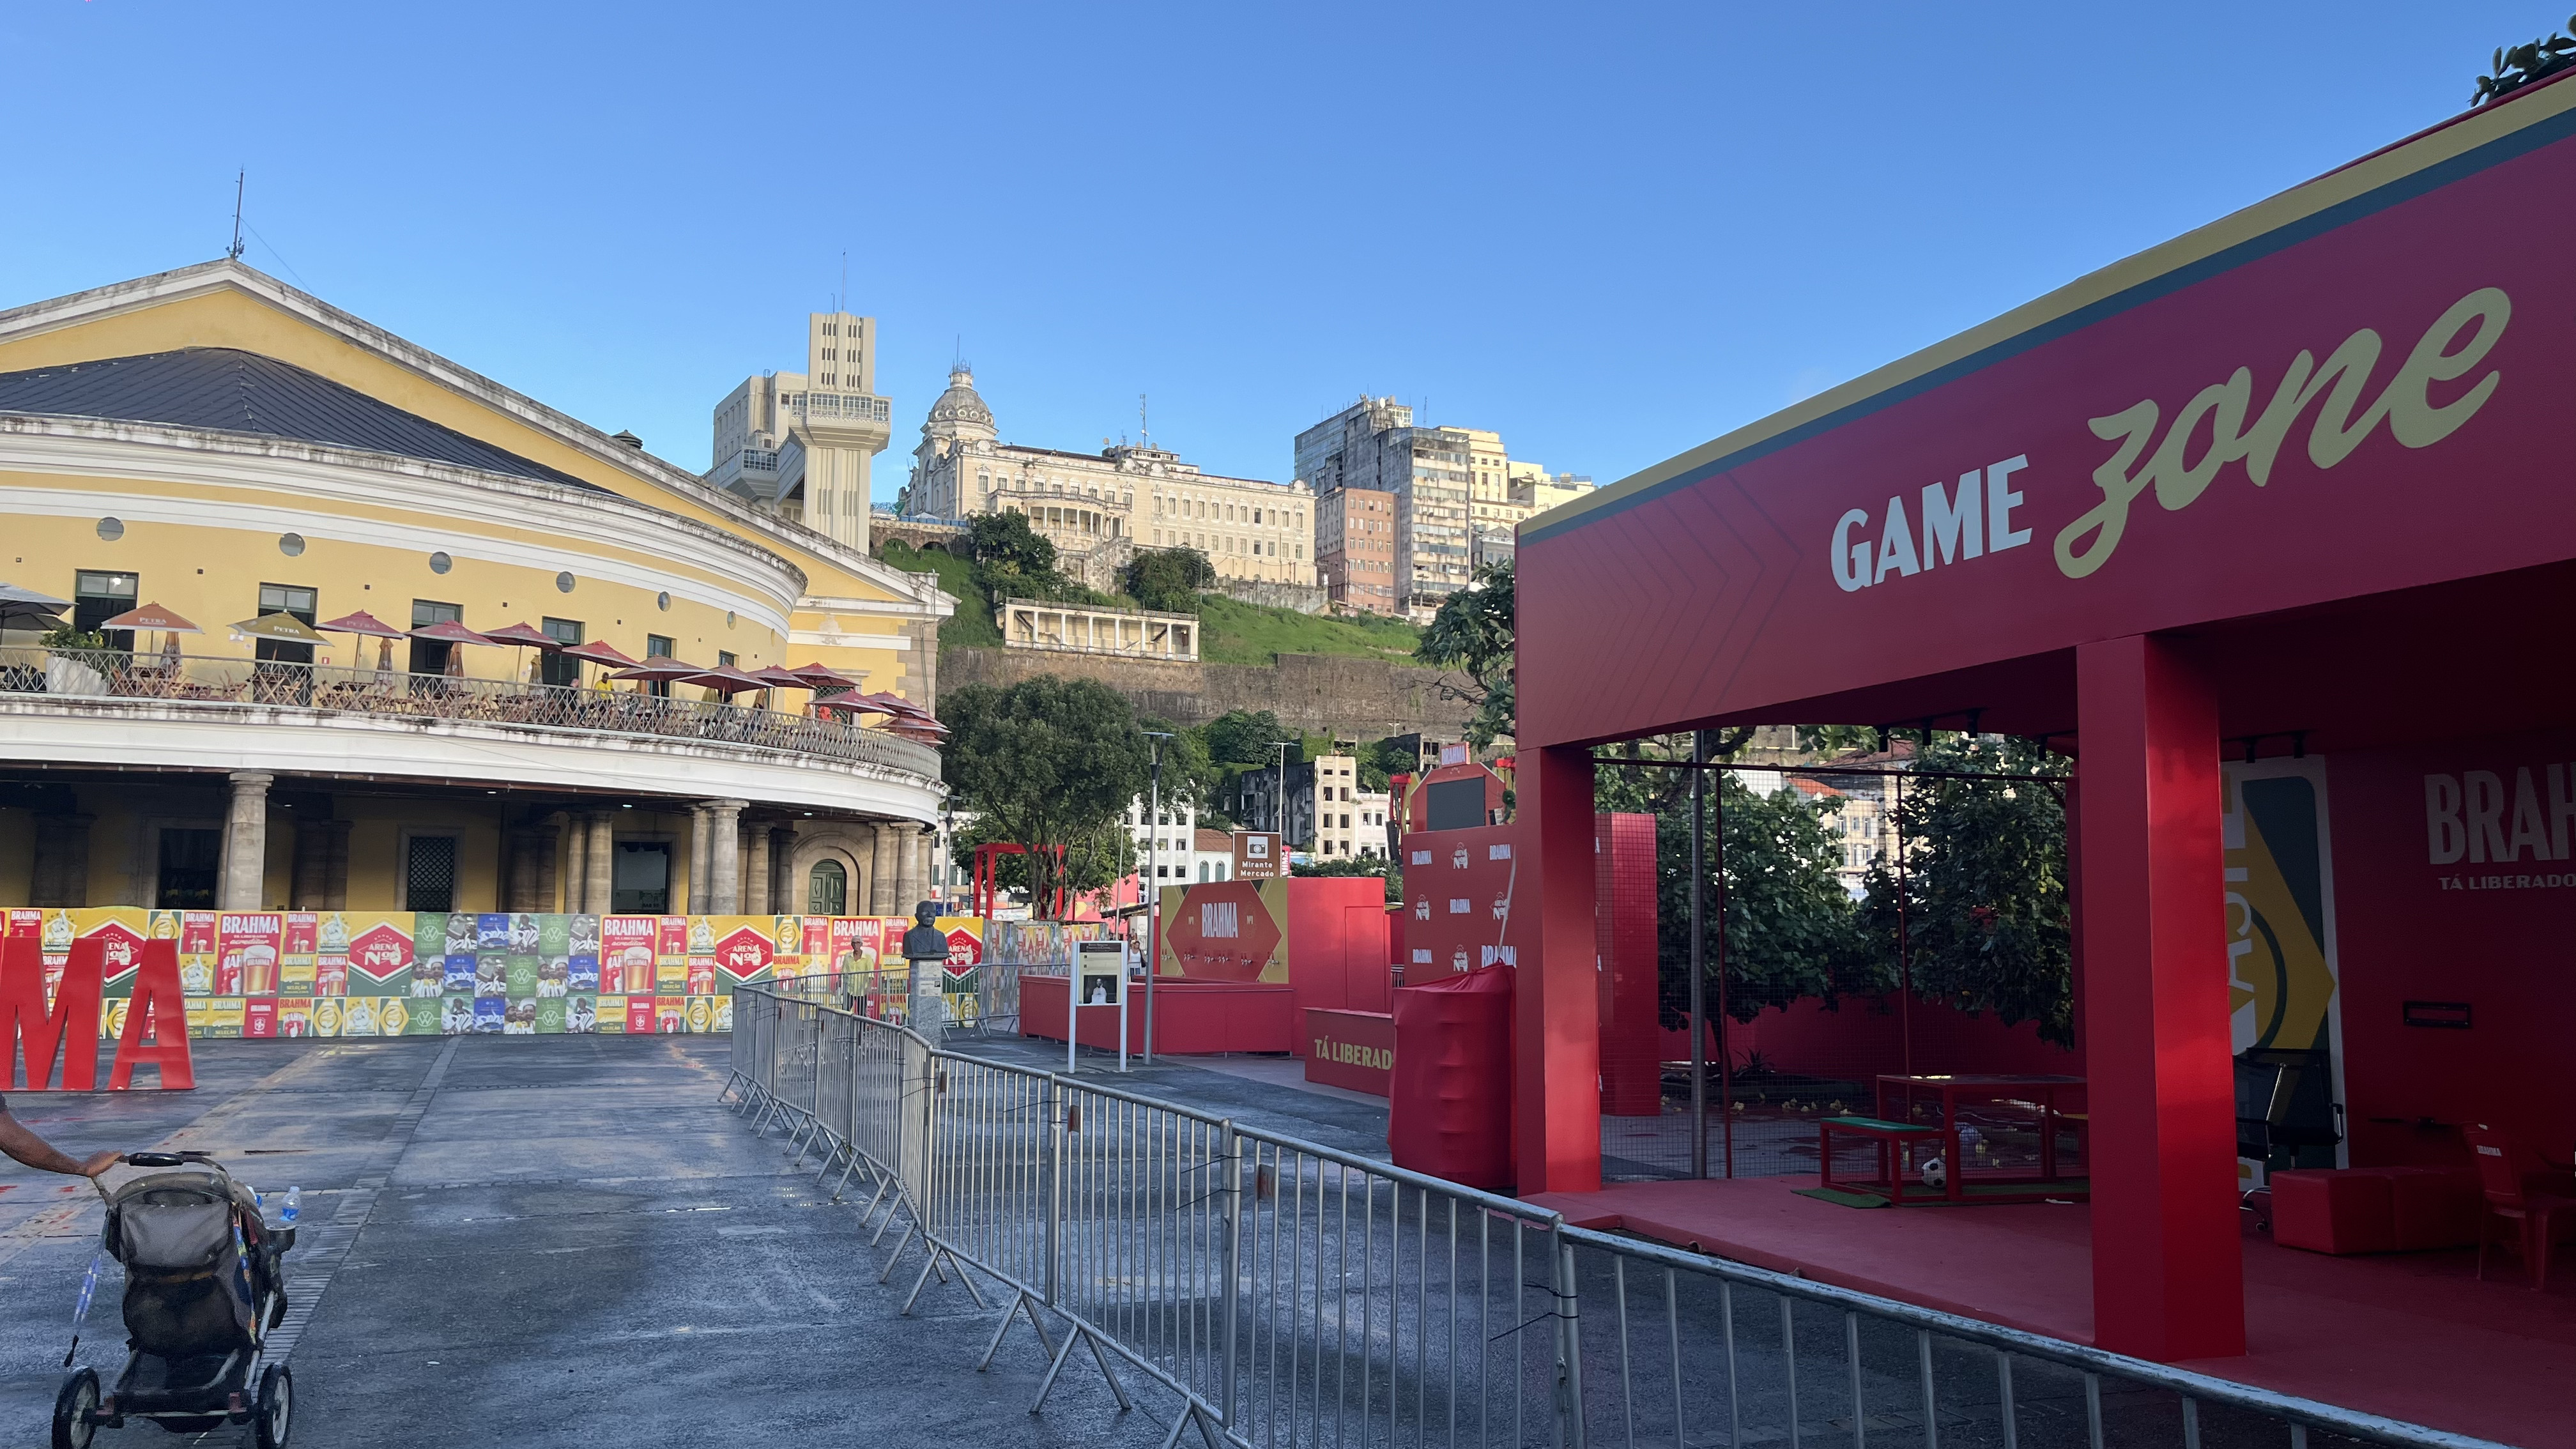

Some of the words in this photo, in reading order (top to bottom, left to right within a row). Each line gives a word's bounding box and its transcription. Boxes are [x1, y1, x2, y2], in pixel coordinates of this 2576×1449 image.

[1830, 453, 2032, 592] GAME
[2053, 287, 2511, 579] zone
[273, 625, 300, 634] PETRA
[1441, 745, 1466, 765] BRAHMA
[1412, 850, 1432, 865] BRAHMA
[1489, 844, 1511, 861] BRAHMA
[2438, 873, 2463, 891] TÁ
[1450, 899, 1471, 913] BRAHMA
[12, 911, 41, 921] BRAHMA
[185, 913, 215, 923] BRAHMA
[288, 914, 316, 923] BRAHMA
[1202, 902, 1238, 938] BRAHMA
[222, 916, 279, 933] BRAHMA
[661, 917, 686, 926] BRAHMA
[804, 917, 827, 926] BRAHMA
[885, 918, 907, 926] BRAHMA
[604, 919, 654, 936] BRAHMA
[833, 920, 879, 936] BRAHMA
[284, 956, 312, 966] BRAHMA
[318, 956, 346, 965] BRAHMA
[774, 956, 799, 965] BRAHMA
[884, 957, 906, 965] BRAHMA
[1413, 949, 1432, 963] BRAHMA
[659, 957, 684, 966] BRAHMA
[689, 957, 714, 966] BRAHMA
[185, 1000, 206, 1010] AHMA
[213, 1000, 242, 1010] BRAHMA
[279, 999, 312, 1008] BRAHMA
[598, 999, 624, 1008] BRAHMA
[657, 997, 684, 1006] BRAHMA
[0, 937, 197, 1090] MA
[1314, 1035, 1330, 1060] TÁ
[1332, 1041, 1393, 1070] LIBERAD
